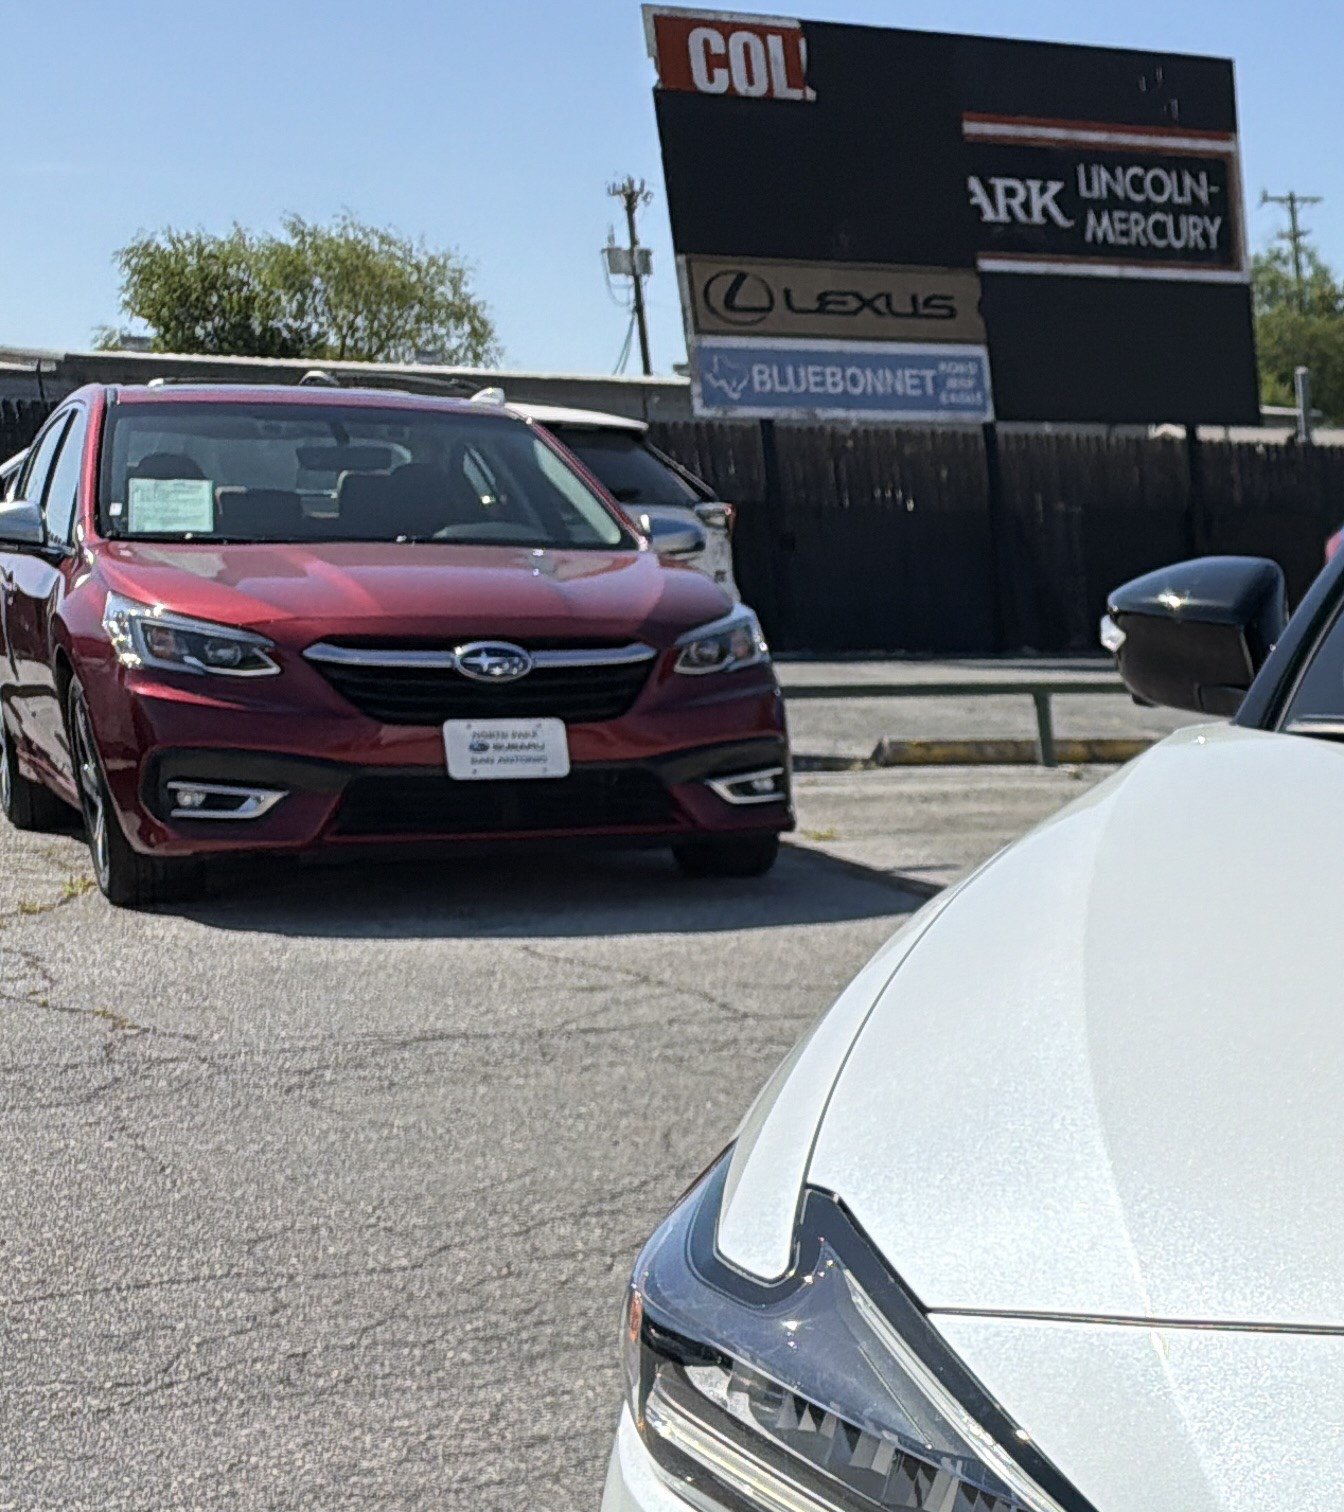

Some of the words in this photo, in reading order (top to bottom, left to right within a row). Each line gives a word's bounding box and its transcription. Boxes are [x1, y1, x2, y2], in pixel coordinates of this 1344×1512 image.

[688, 27, 816, 101] COL
[1076, 163, 1220, 206] LINCOLN-
[1084, 208, 1222, 250] MERCURY
[783, 287, 958, 319] LEXUS
[751, 363, 938, 397] BLUEBONNET
